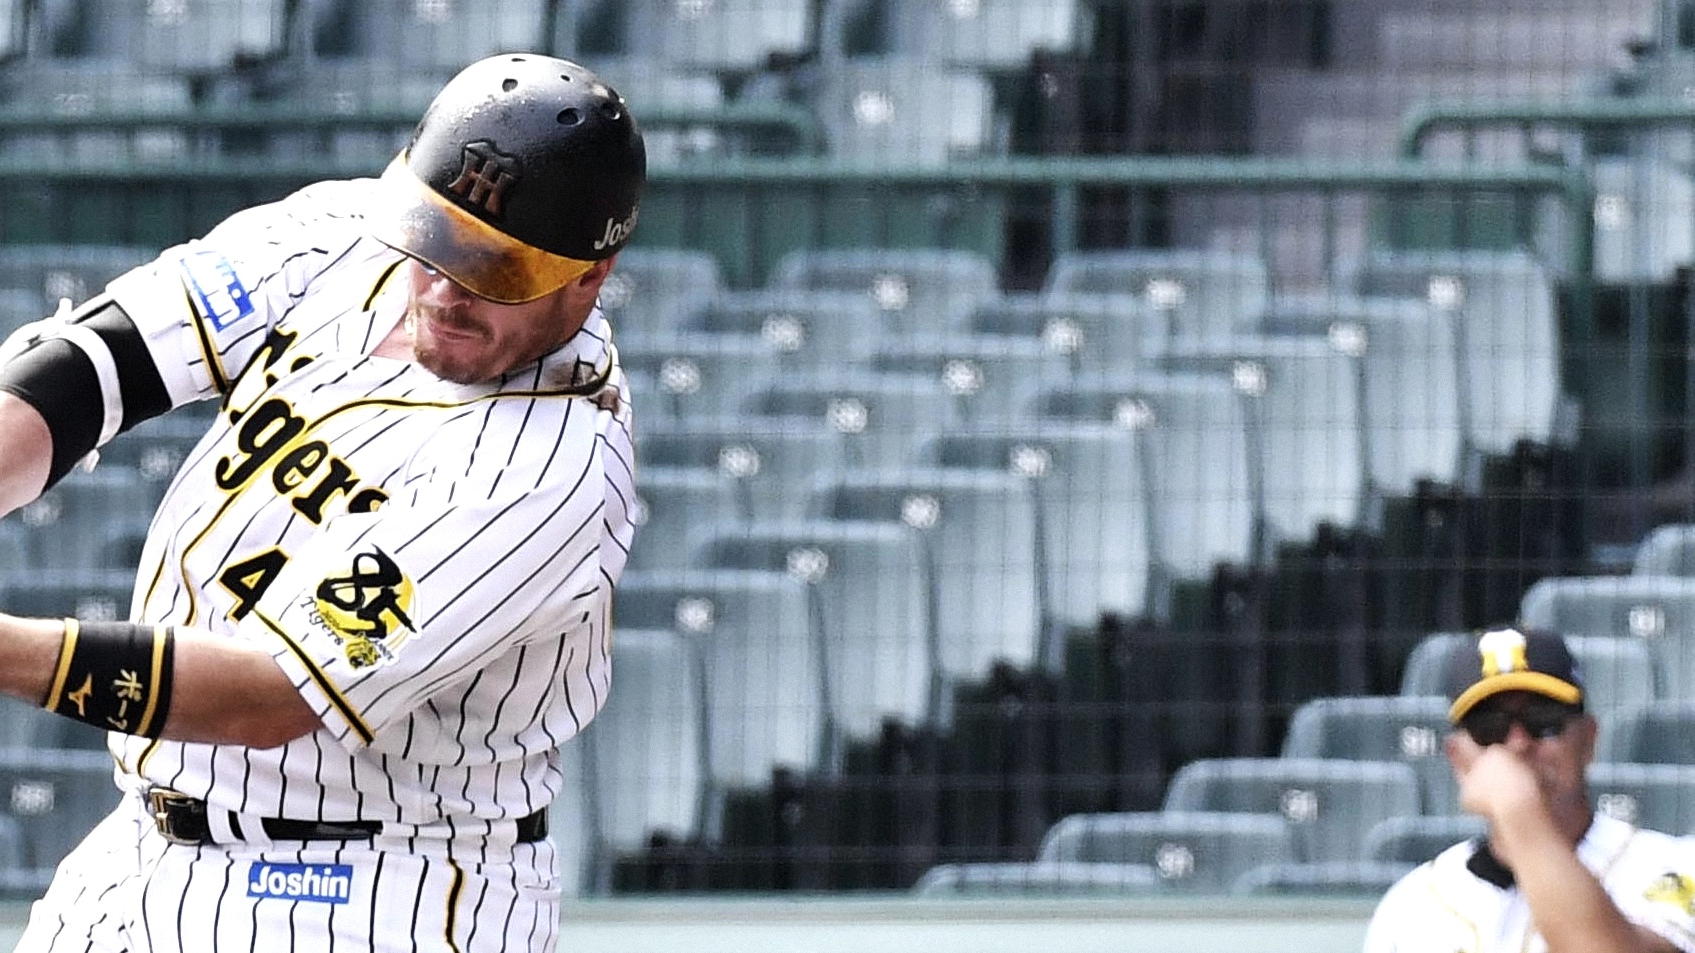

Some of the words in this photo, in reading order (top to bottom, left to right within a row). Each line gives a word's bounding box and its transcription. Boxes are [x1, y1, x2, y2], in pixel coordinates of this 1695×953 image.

[219, 548, 290, 622] 4
[316, 543, 418, 639] 85
[250, 865, 349, 898] Joshin
